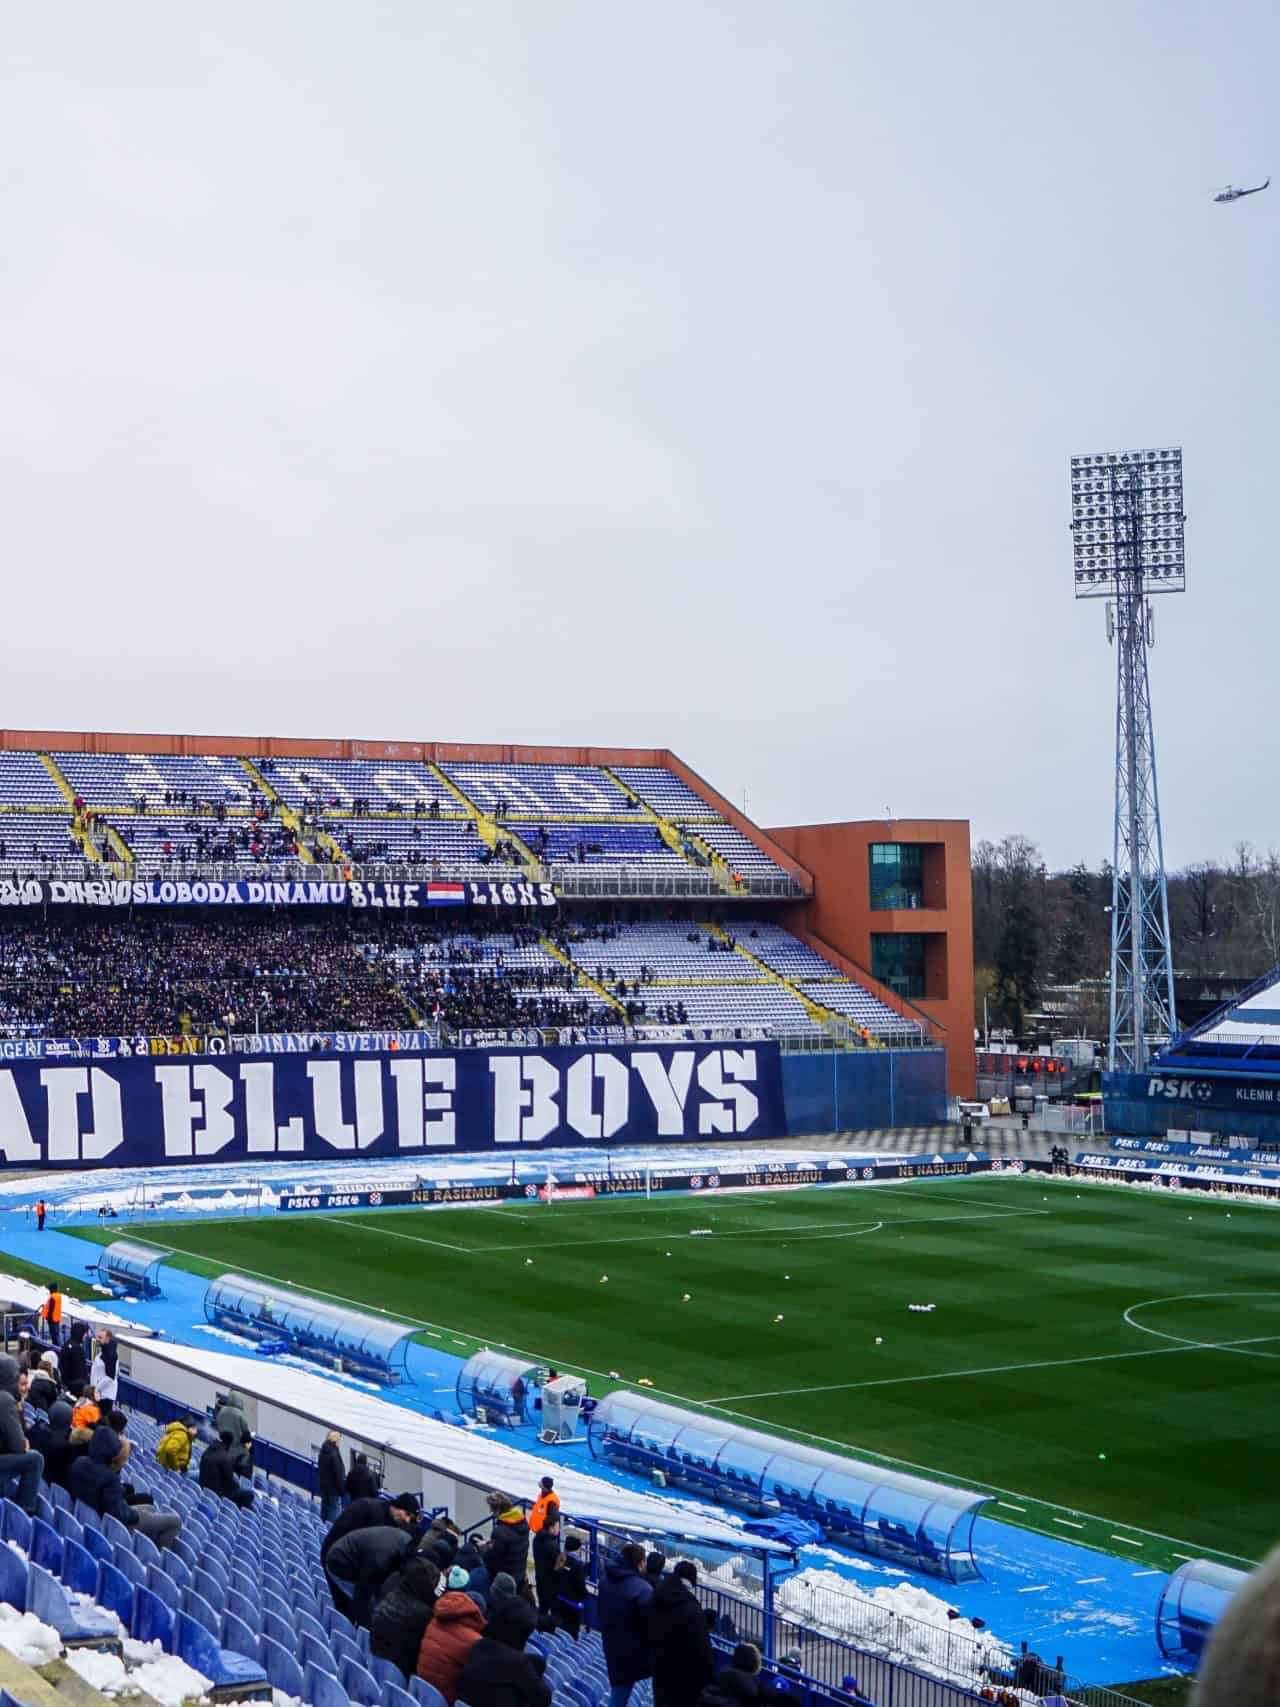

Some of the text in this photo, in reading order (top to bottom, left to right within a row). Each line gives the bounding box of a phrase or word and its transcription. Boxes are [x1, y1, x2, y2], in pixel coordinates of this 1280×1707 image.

[51, 880, 132, 905] DINAMO
[133, 882, 346, 904] SLOBODA DINAMU
[348, 882, 557, 907] BLUE LIONS
[1148, 1079, 1195, 1099] PSK
[1236, 1088, 1273, 1101] KLEMM
[154, 1057, 456, 1157] BLUE
[489, 1050, 759, 1142] BOYS
[1115, 1138, 1134, 1148] PSK
[1145, 1141, 1163, 1151] PSK
[1082, 1155, 1103, 1166] PSK
[1117, 1159, 1139, 1169] PSK
[1160, 1162, 1181, 1172] PSK
[746, 1174, 761, 1185] NE
[288, 1196, 312, 1208] PSK
[328, 1195, 352, 1207] PSK
[412, 1191, 429, 1202] NE
